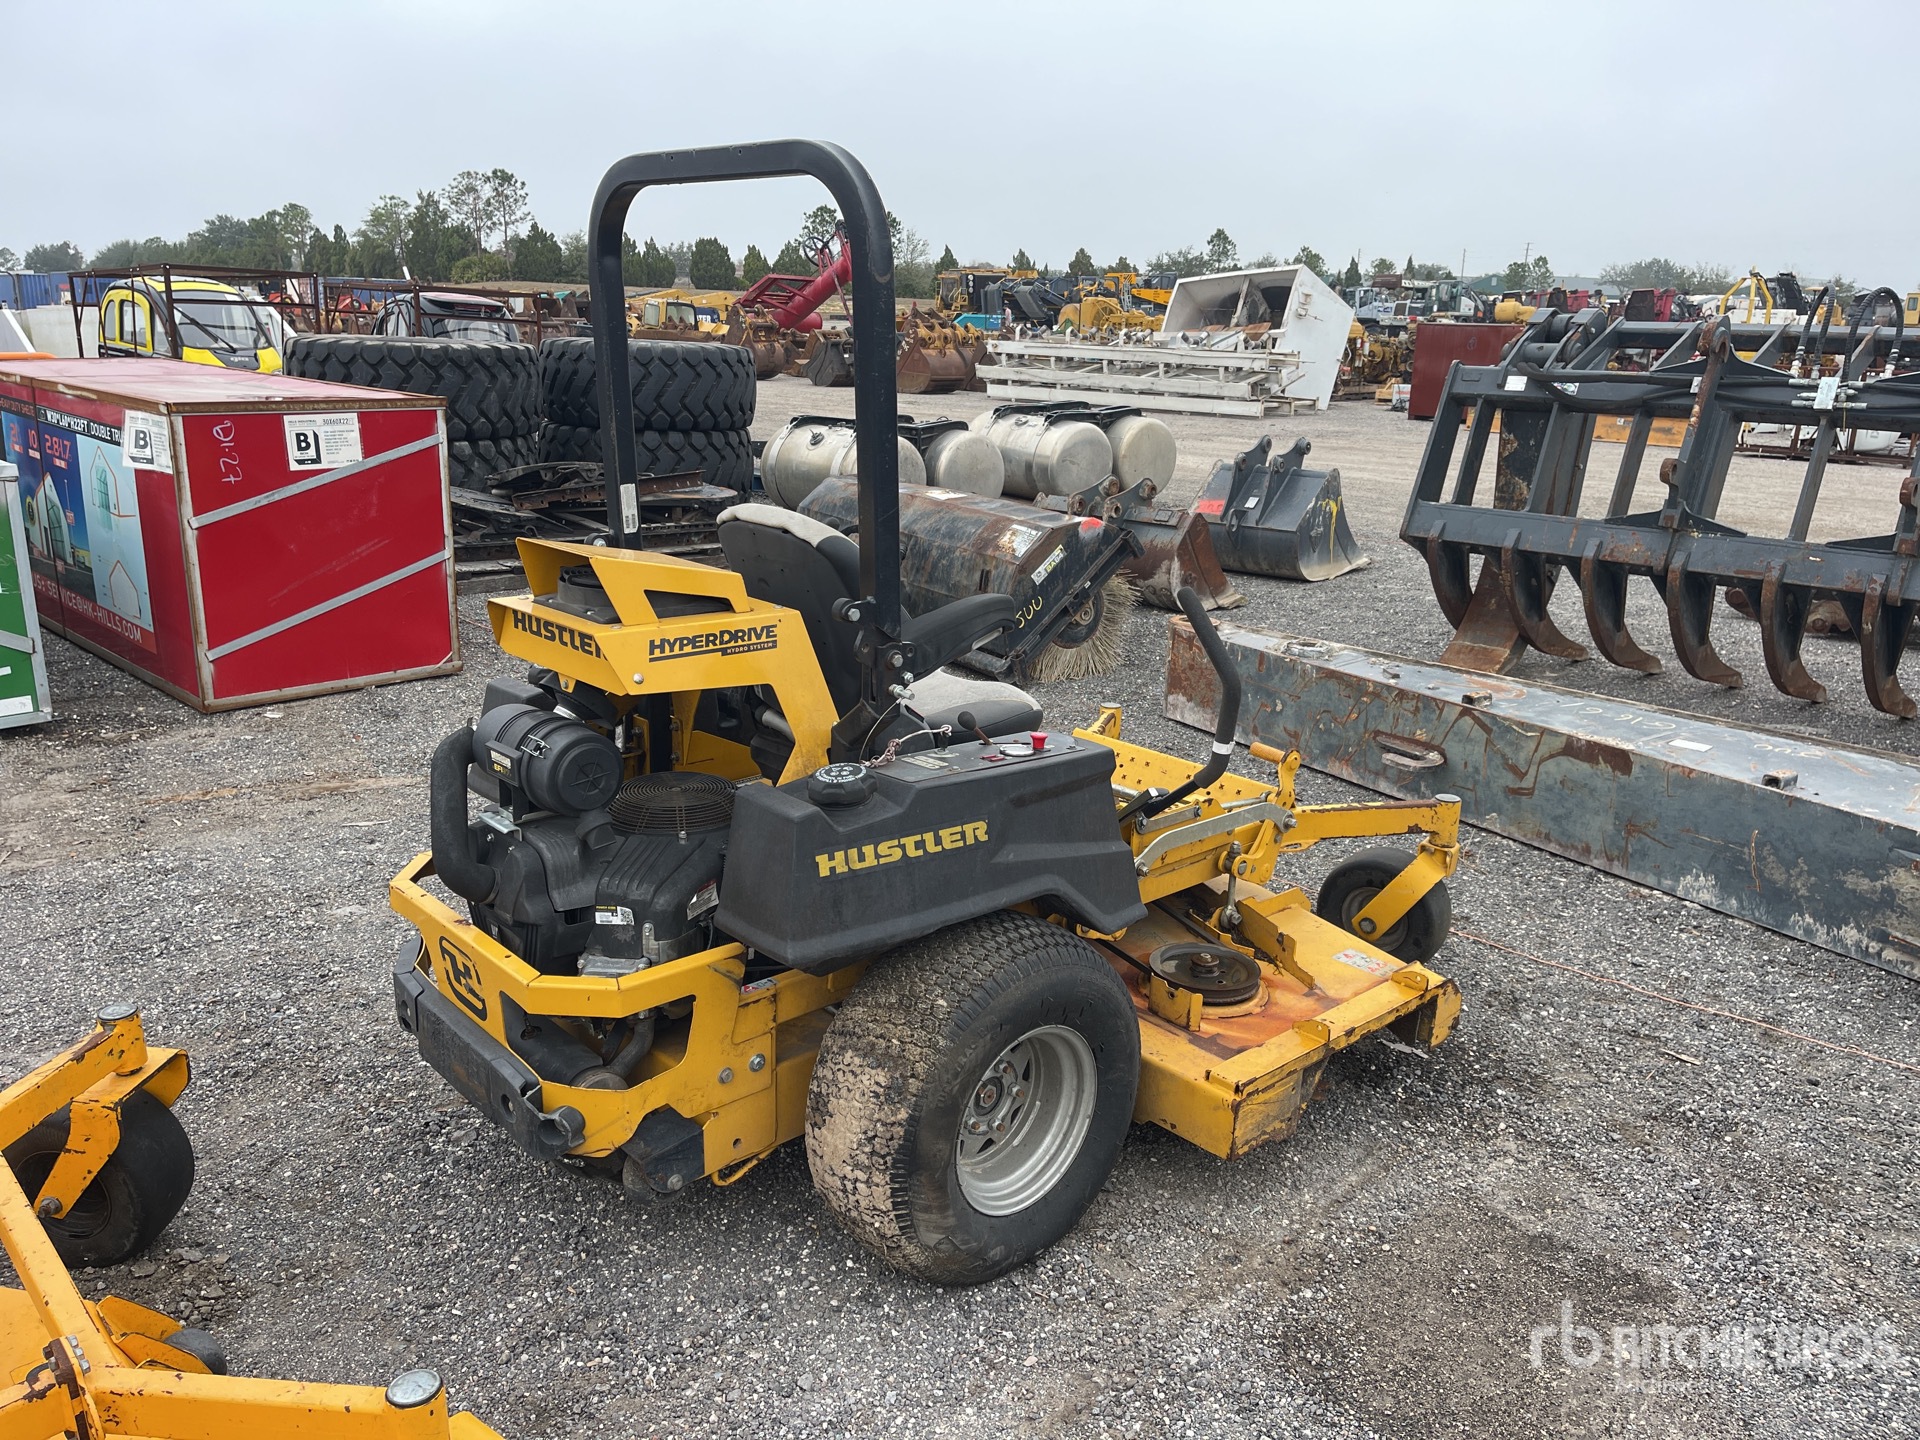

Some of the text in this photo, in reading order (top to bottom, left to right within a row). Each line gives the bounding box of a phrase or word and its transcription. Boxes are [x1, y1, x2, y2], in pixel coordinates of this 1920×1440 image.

[90, 422, 111, 440] DOUBLE
[134, 429, 149, 450] B
[295, 432, 312, 452] B
[648, 623, 778, 657] HYPERDRIVE
[727, 642, 773, 654] HYDRO SYSTEM
[815, 820, 989, 878] HUSTLER
